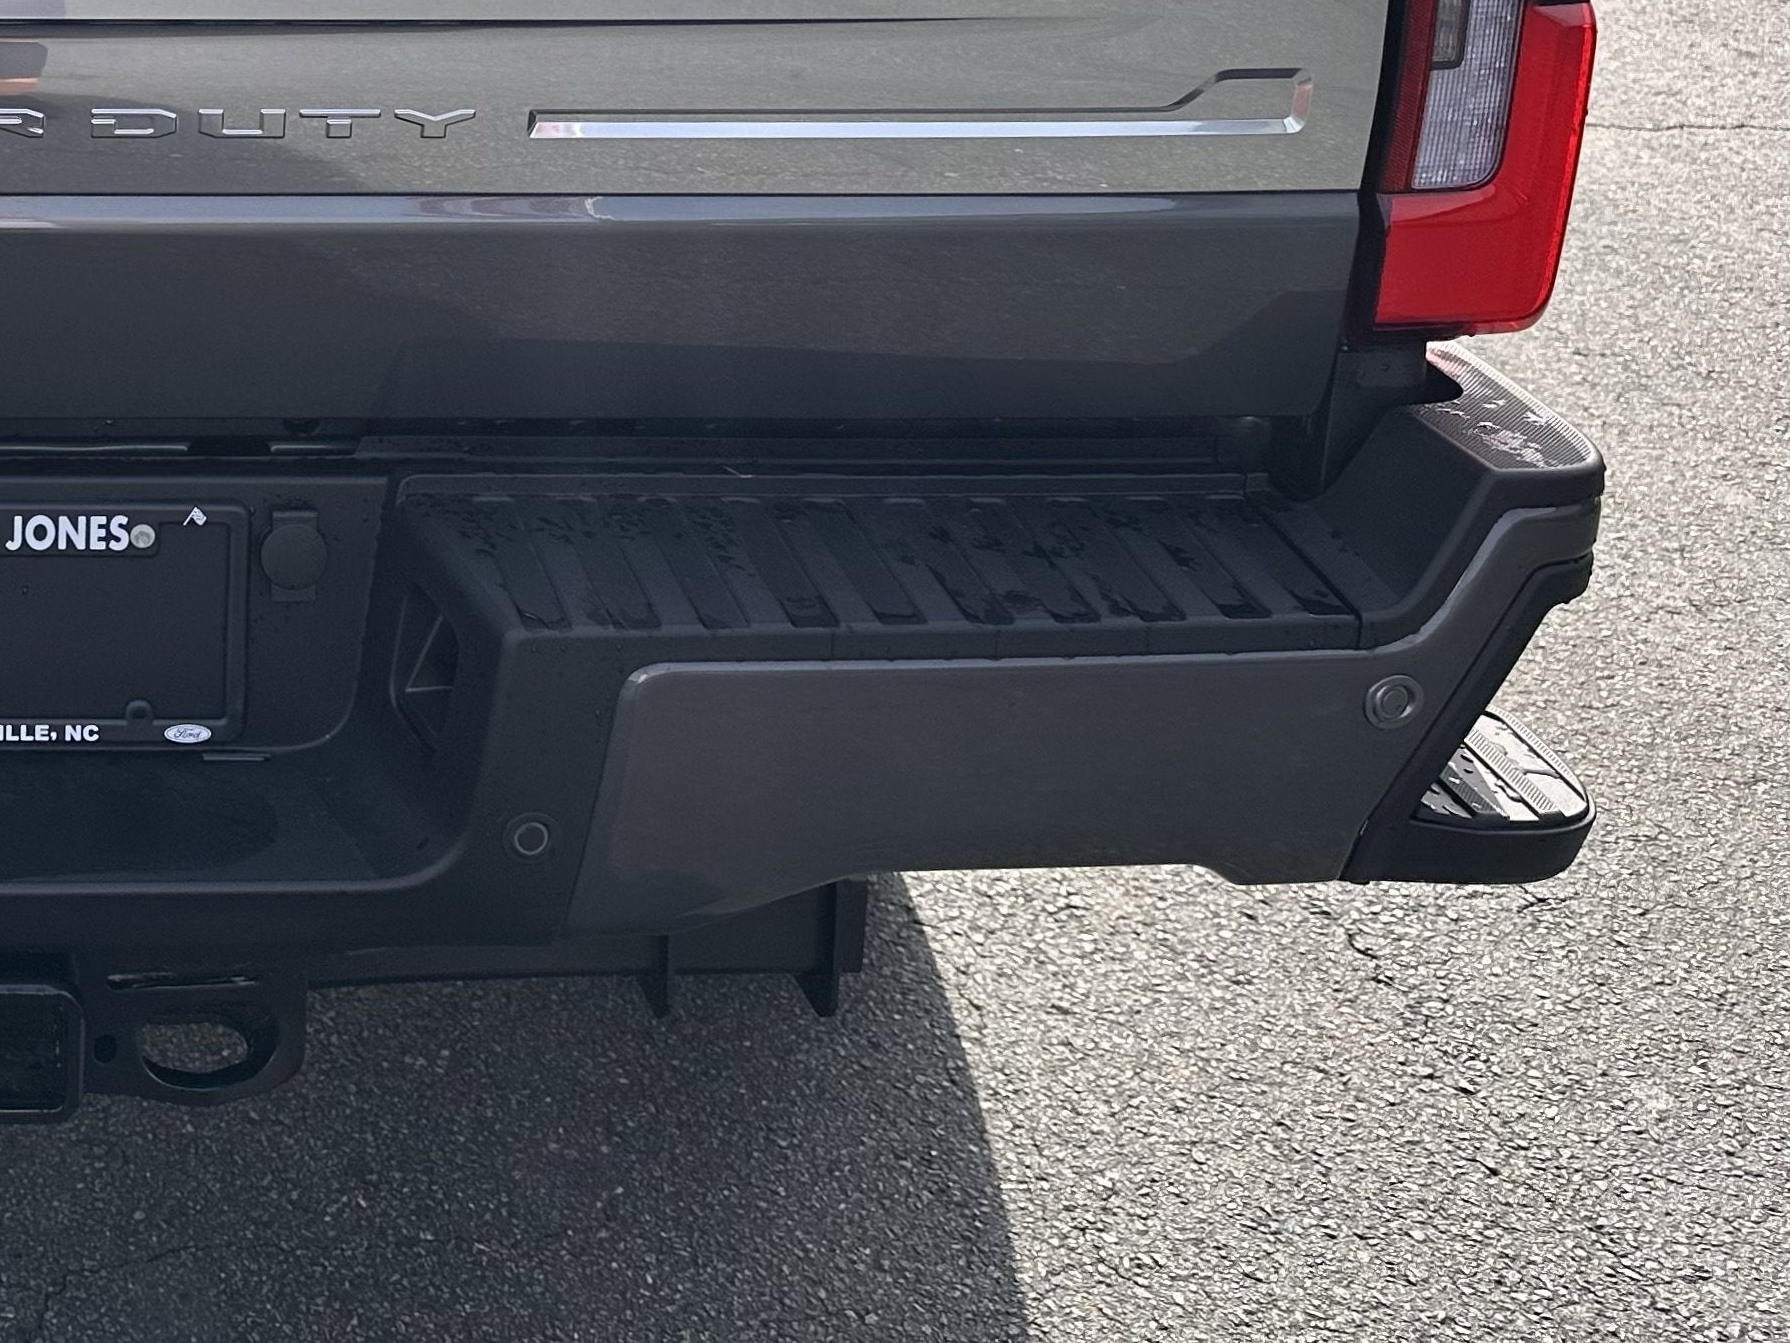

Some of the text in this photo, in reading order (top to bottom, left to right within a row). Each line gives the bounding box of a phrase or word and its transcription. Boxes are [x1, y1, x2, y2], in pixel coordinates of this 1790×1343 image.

[90, 108, 477, 139] DUTY
[5, 515, 129, 551] JONES
[65, 725, 100, 741] NC
